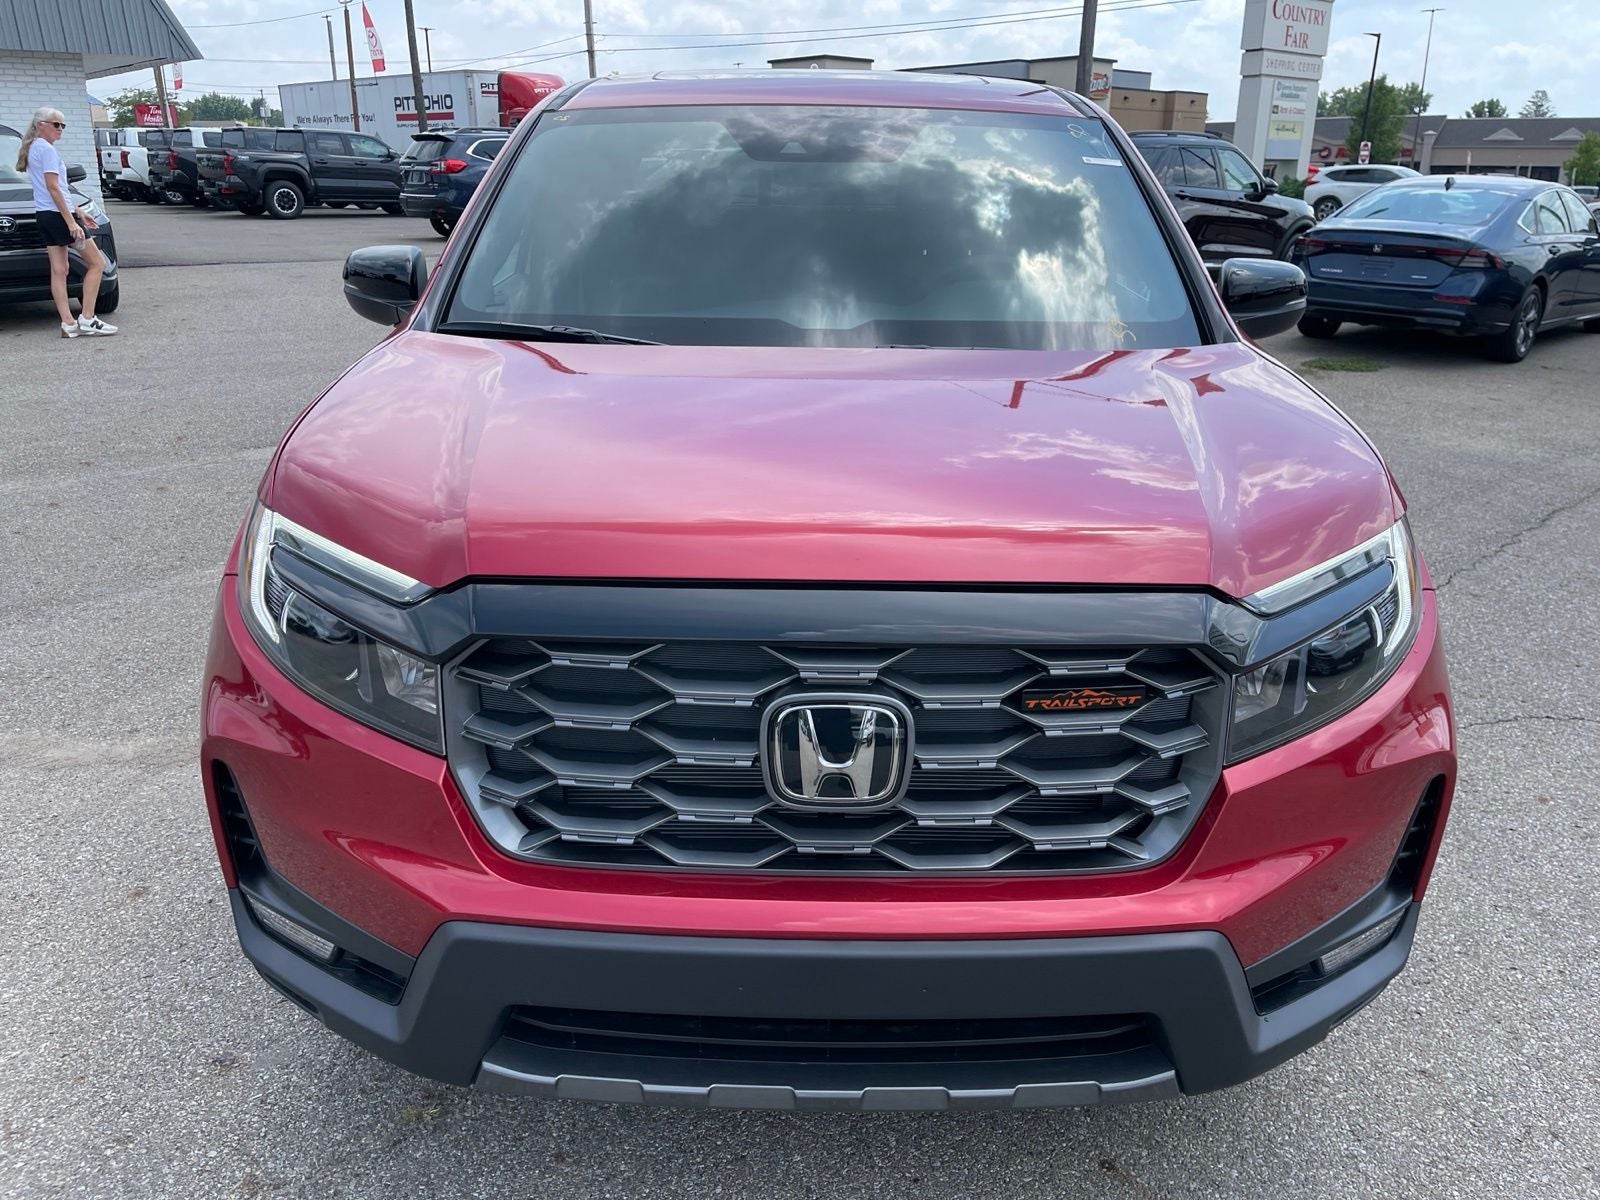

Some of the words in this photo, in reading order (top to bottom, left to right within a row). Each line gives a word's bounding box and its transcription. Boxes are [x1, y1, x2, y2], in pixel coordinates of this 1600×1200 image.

[1272, 0, 1328, 26] COUNTRY
[1284, 25, 1309, 49] FAIR
[312, 114, 333, 125] Always
[333, 114, 350, 123] There
[1025, 695, 1142, 709] TRAILSPORT
